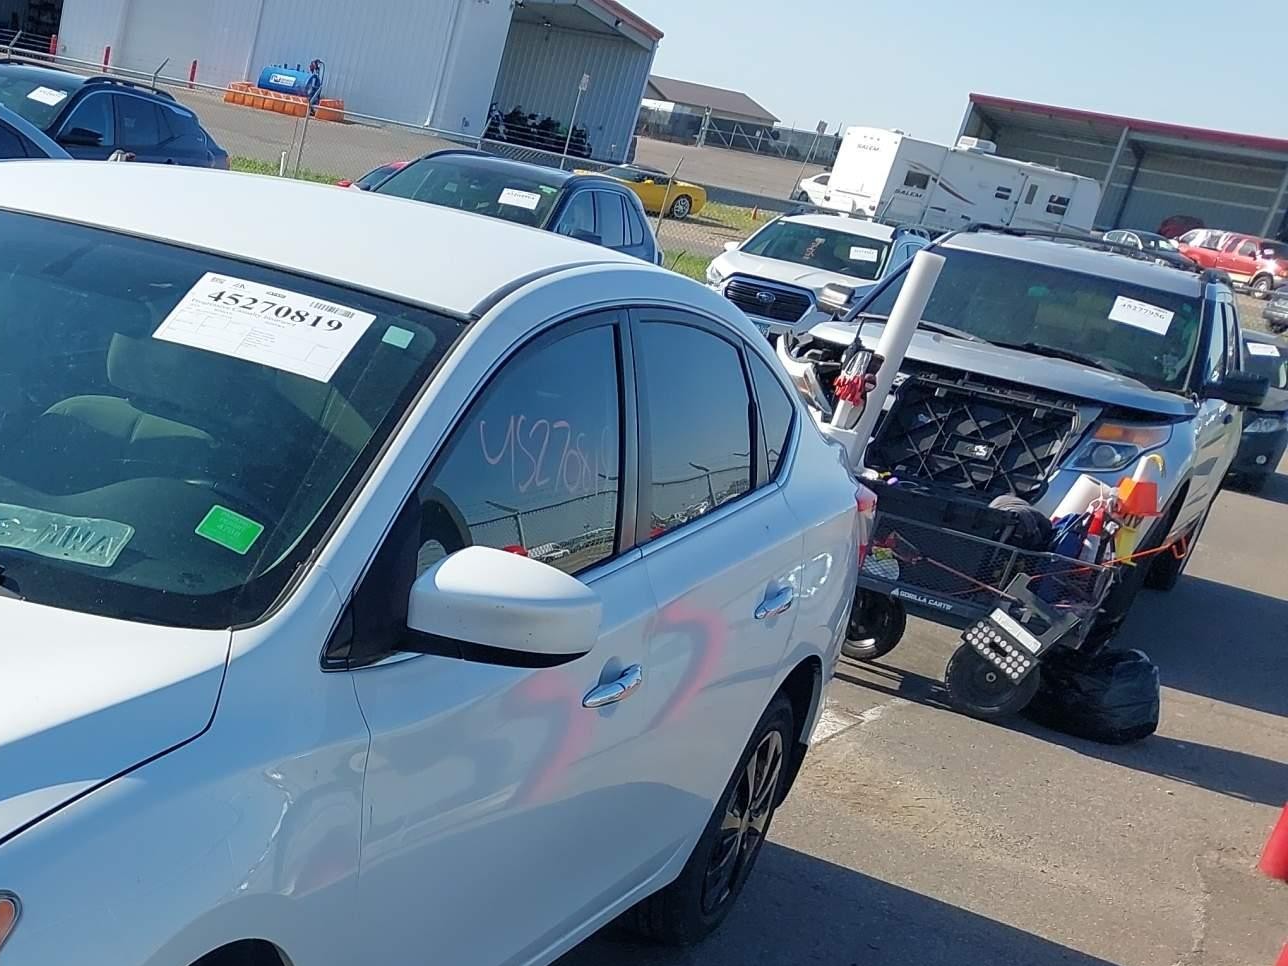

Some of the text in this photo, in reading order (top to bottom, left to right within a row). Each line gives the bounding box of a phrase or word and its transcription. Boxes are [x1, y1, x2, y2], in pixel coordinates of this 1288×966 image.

[857, 143, 880, 151] SALEM
[894, 188, 923, 198] SALEM
[208, 289, 343, 332] 45270819
[900, 590, 927, 603] GORILLA
